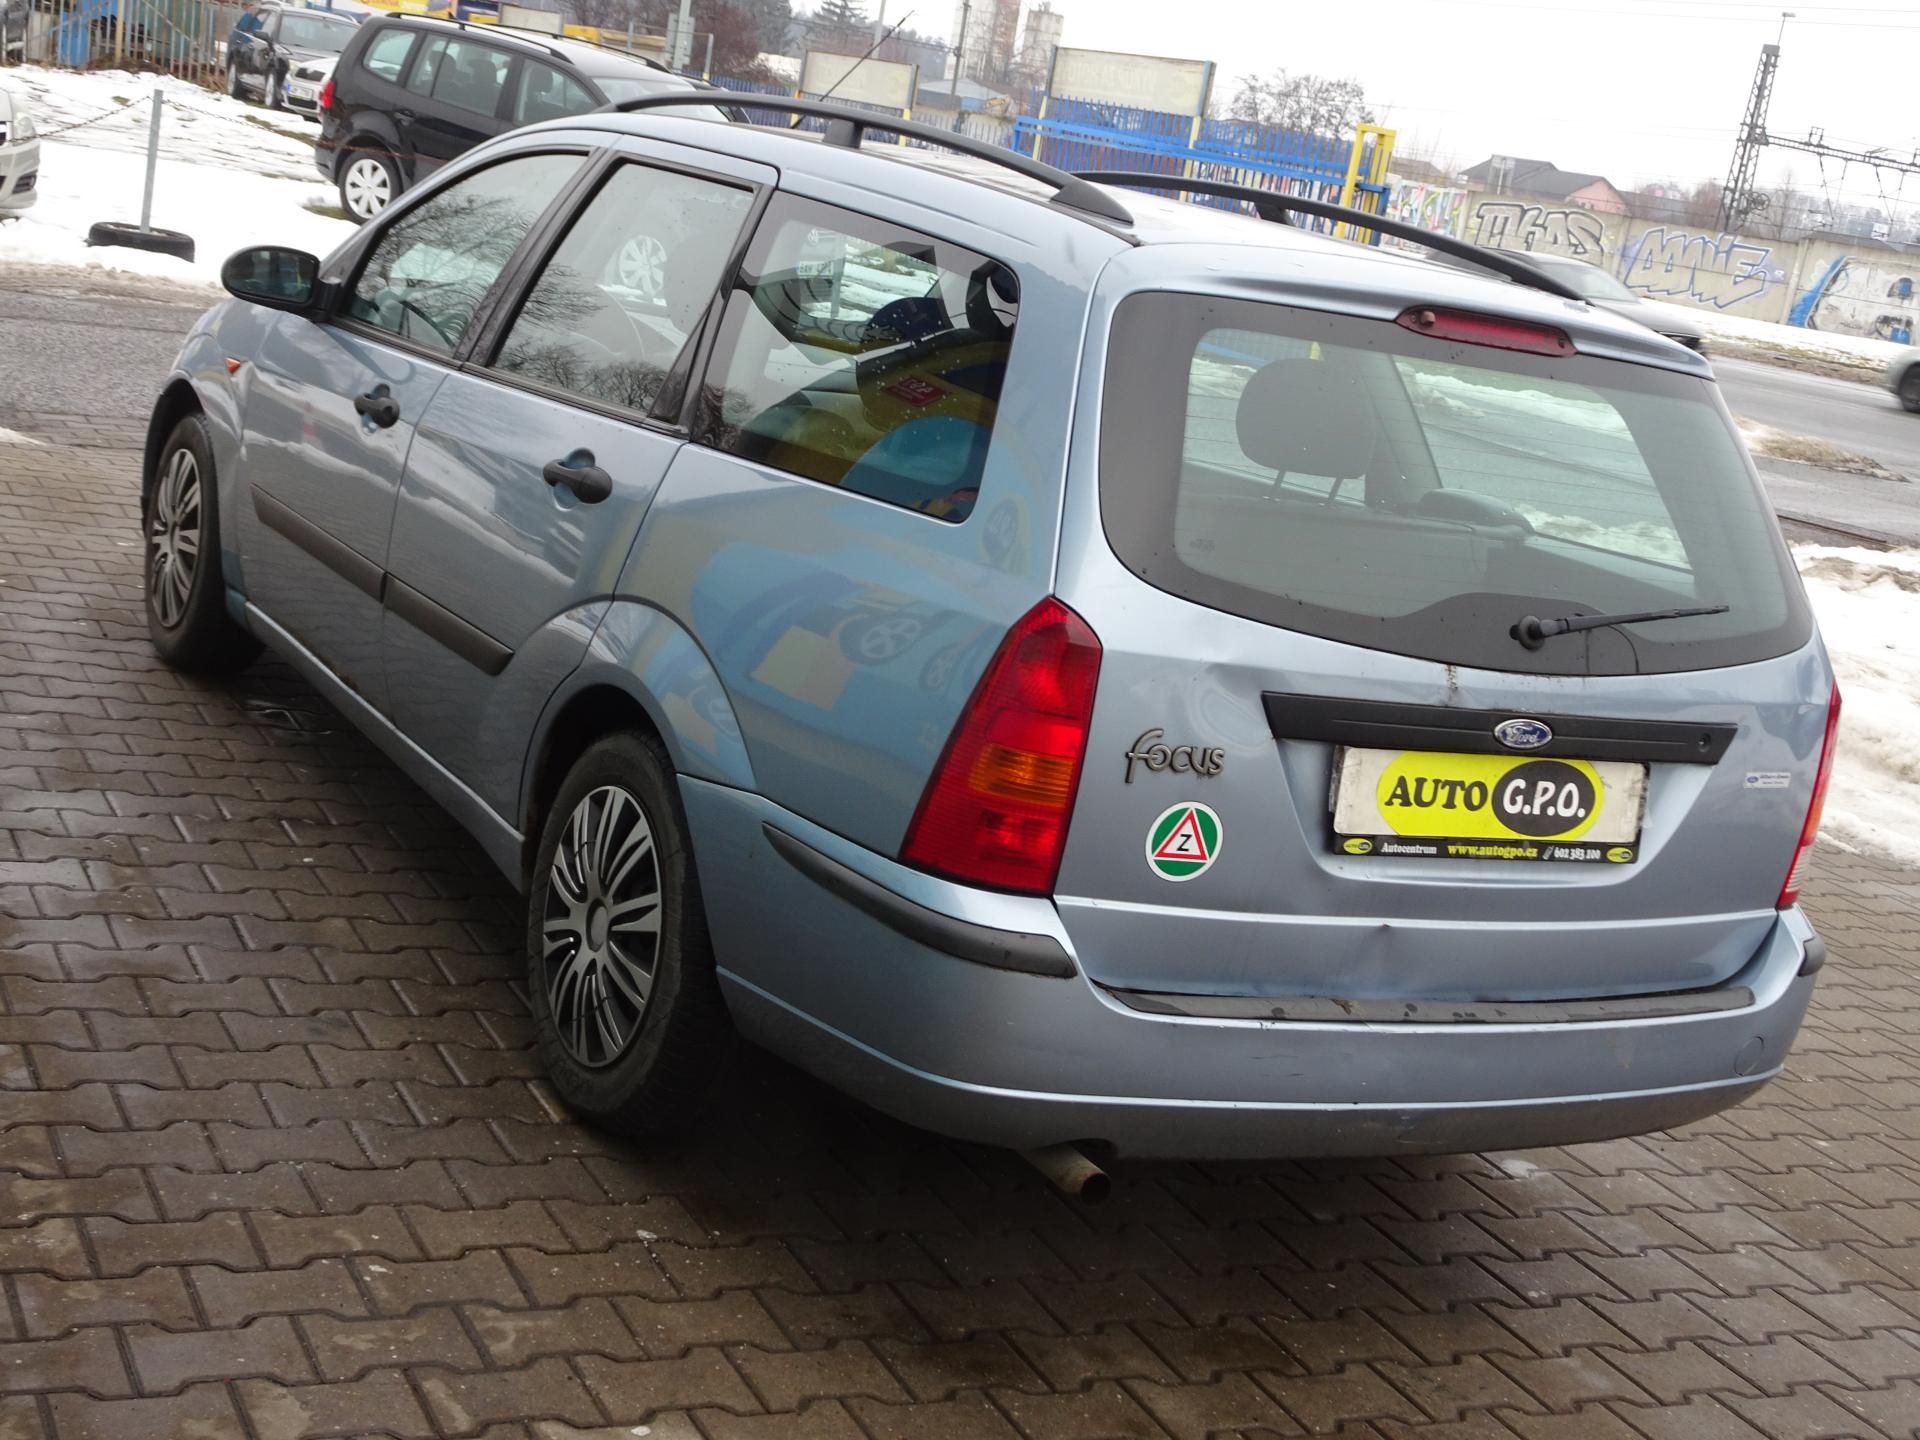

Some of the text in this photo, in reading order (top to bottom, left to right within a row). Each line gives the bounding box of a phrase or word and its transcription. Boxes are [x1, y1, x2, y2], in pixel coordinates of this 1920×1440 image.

[1384, 775, 1587, 817] AUTO G.P.O.
[1176, 834, 1193, 852] Z
[1381, 842, 1438, 855] Autocentrum
[1447, 843, 1539, 858] www.autogpo.cz
